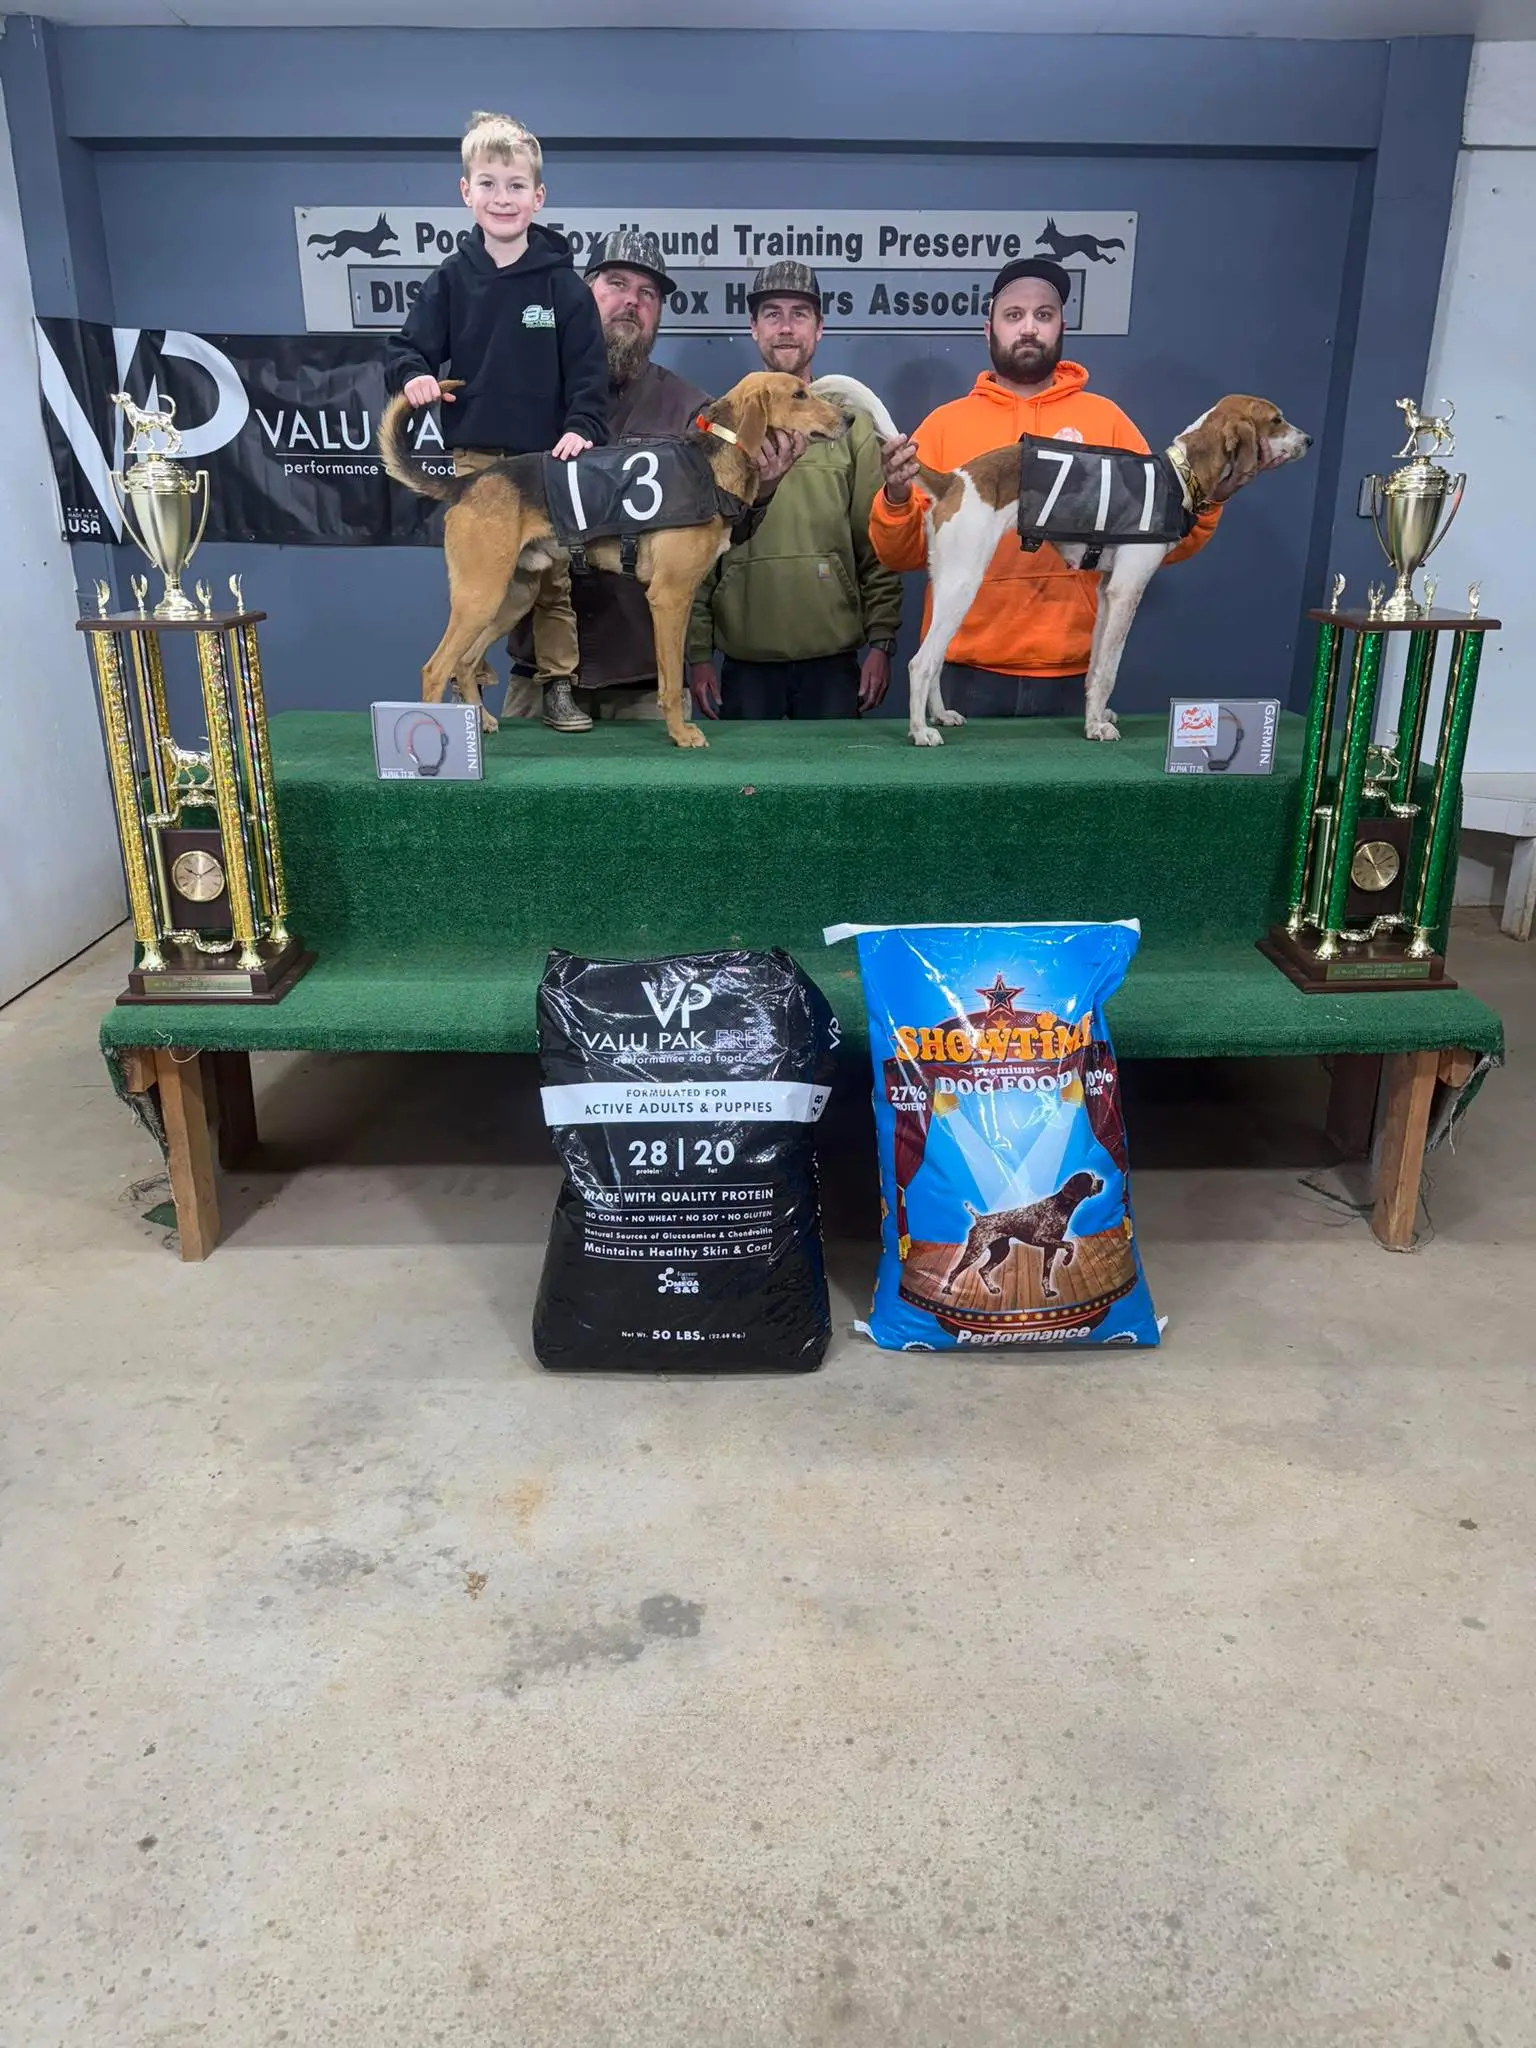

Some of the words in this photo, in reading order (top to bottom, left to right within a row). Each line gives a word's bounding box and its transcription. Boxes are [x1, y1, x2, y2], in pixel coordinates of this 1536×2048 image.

[547, 223, 603, 255] ox
[619, 224, 718, 255] und
[733, 224, 863, 263] Training
[879, 225, 1021, 258] Preserve
[663, 291, 709, 315] ox
[868, 283, 993, 316] Associa
[255, 408, 371, 451] VALU
[284, 460, 379, 477] performance
[1035, 449, 1156, 532] 711
[68, 519, 101, 535] USA
[464, 709, 478, 773] GARMIN
[1259, 704, 1276, 767] GARMIN
[641, 981, 712, 1029] VP
[581, 1031, 648, 1051] VALU
[658, 1030, 706, 1050] PAK
[689, 1052, 711, 1065] dog
[973, 1065, 1036, 1077] Premium
[938, 1076, 991, 1096] DOG
[999, 1070, 1073, 1093] FOOD
[626, 1088, 701, 1098] FORMULATED
[705, 1088, 727, 1098] FOR
[890, 1085, 928, 1102] 27%
[585, 1103, 633, 1116] ACTIVE
[639, 1102, 694, 1114] ADULTS
[700, 1103, 709, 1114] &
[715, 1101, 773, 1114] PUPPIES
[628, 1139, 668, 1167] 28
[694, 1139, 735, 1166] 20
[584, 1190, 620, 1203] MADE
[624, 1192, 656, 1203] WITH
[661, 1191, 717, 1203] QUALITY
[722, 1188, 774, 1201] PROTEIN
[585, 1211, 597, 1220] NO
[598, 1214, 623, 1222] CORN
[631, 1215, 645, 1223] NO
[648, 1215, 677, 1223] WHEAT
[685, 1214, 700, 1222] NO
[702, 1214, 719, 1222] SOY
[727, 1213, 741, 1221] NO
[743, 1210, 773, 1220] GLUTEN
[584, 1227, 614, 1239] Natural
[615, 1232, 648, 1240] Sources
[650, 1232, 660, 1240] of
[662, 1231, 717, 1241] Glucosamine
[727, 1226, 773, 1239] Chondroitin
[584, 1241, 645, 1257] Maintains
[649, 1246, 698, 1259] Healthy
[702, 1246, 729, 1257] Skin
[733, 1245, 742, 1255] &
[652, 1330, 671, 1340] 50
[676, 1330, 706, 1341] LBS.
[956, 1325, 1091, 1345] Performance
